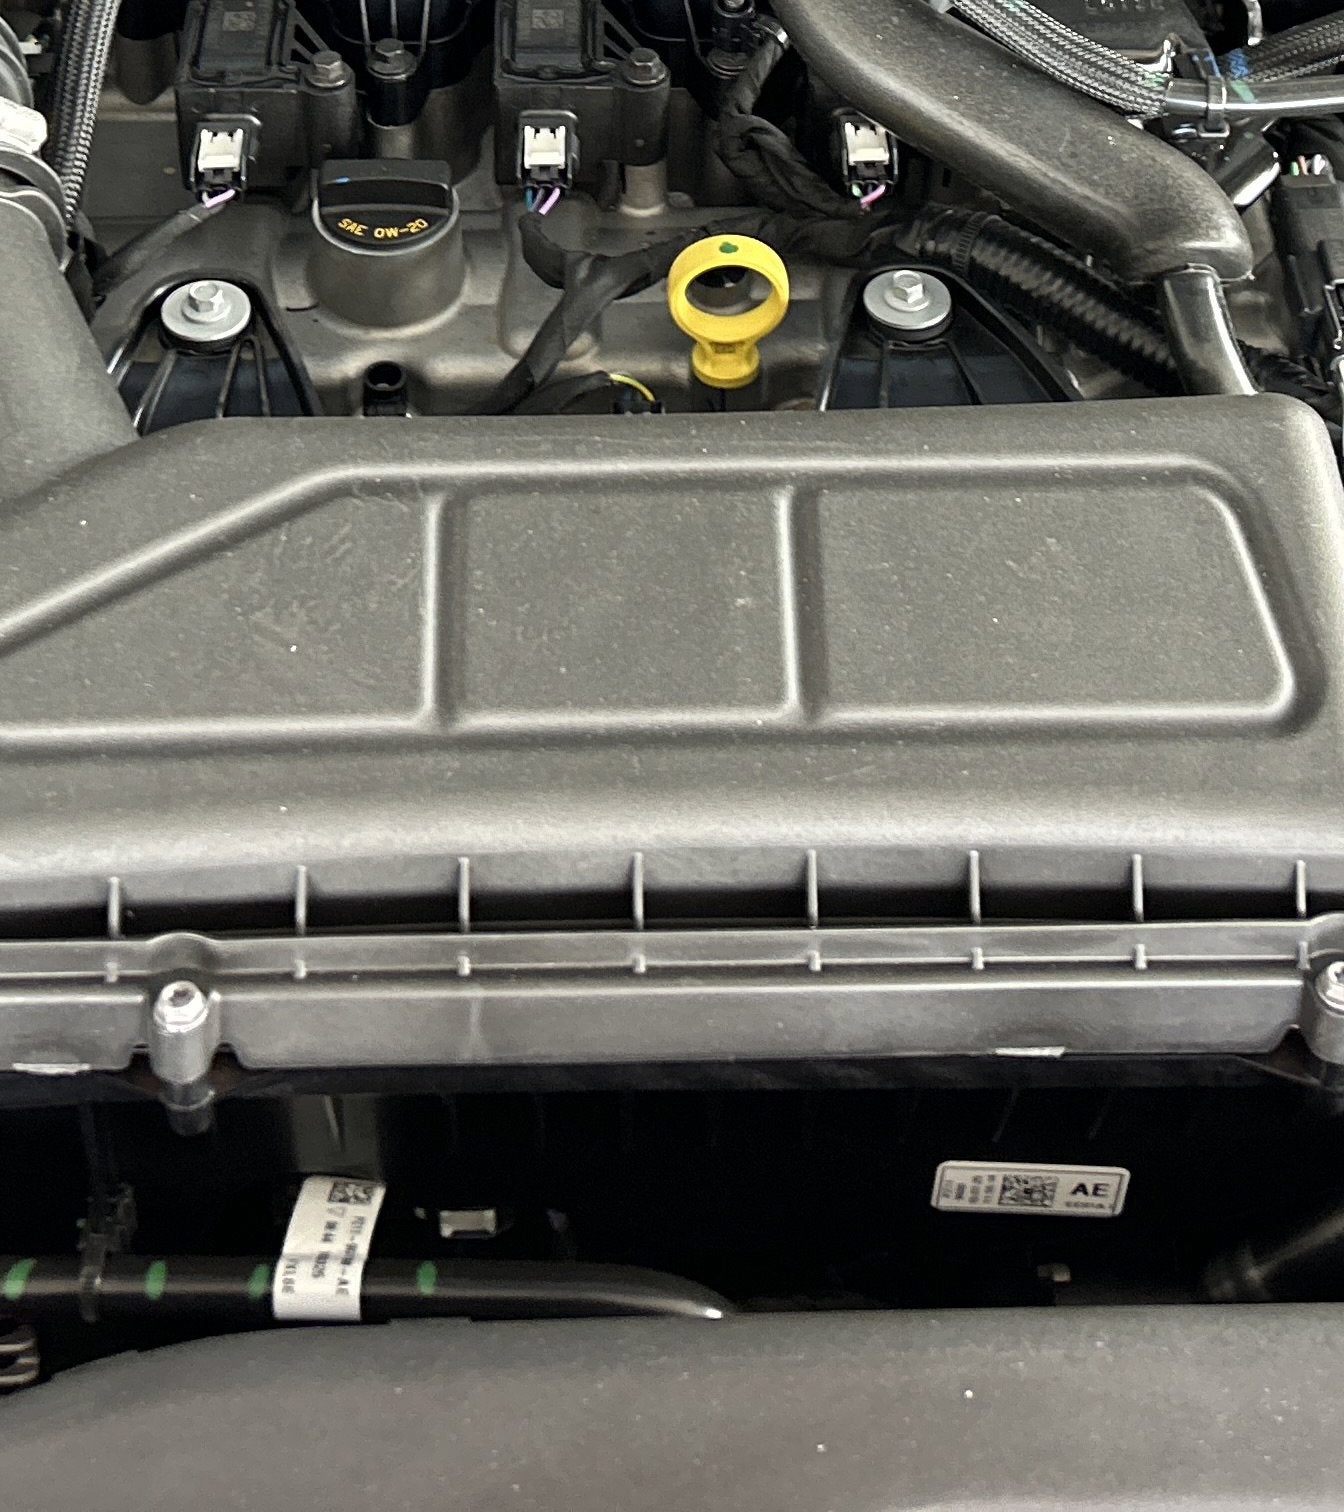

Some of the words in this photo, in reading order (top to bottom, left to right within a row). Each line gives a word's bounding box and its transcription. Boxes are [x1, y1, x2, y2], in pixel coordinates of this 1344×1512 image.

[338, 218, 368, 236] SAE
[373, 218, 429, 239] 0W-20
[1070, 1182, 1111, 1198] AE
